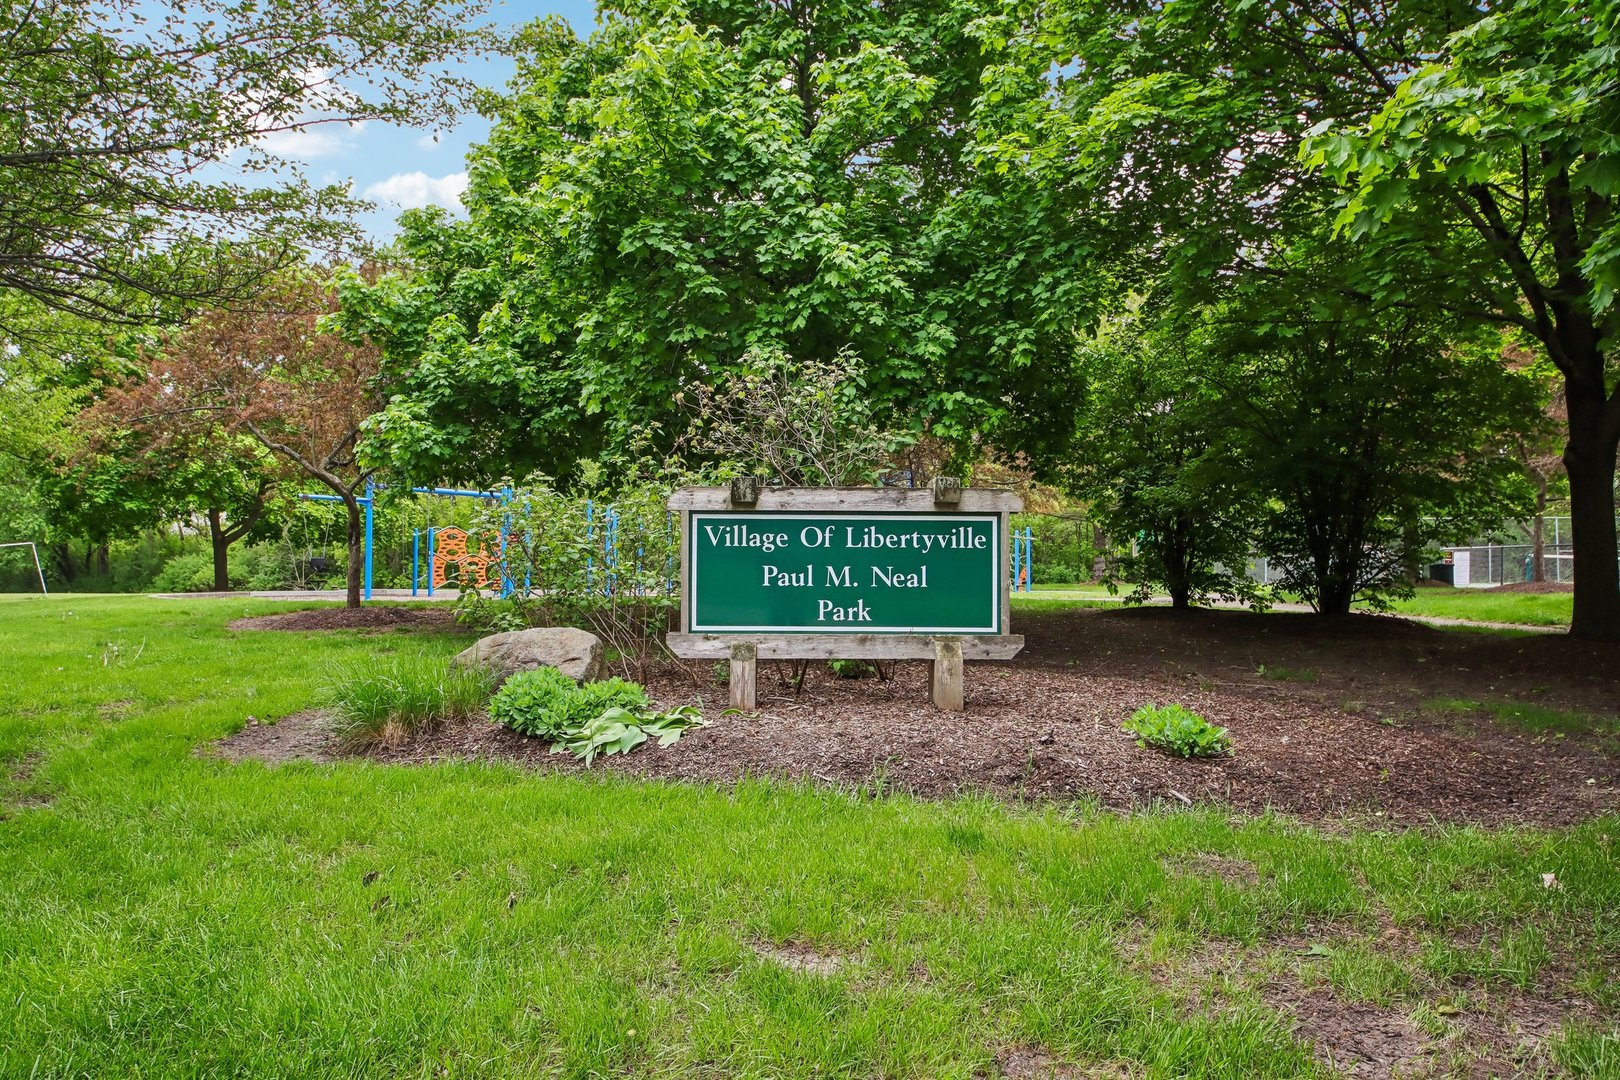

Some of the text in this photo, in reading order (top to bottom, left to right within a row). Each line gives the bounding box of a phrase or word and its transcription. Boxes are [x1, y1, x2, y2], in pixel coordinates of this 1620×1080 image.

[703, 525, 987, 554] Village Of Libertyville
[762, 564, 928, 588] Paul M. Neal
[817, 599, 872, 622] Park
